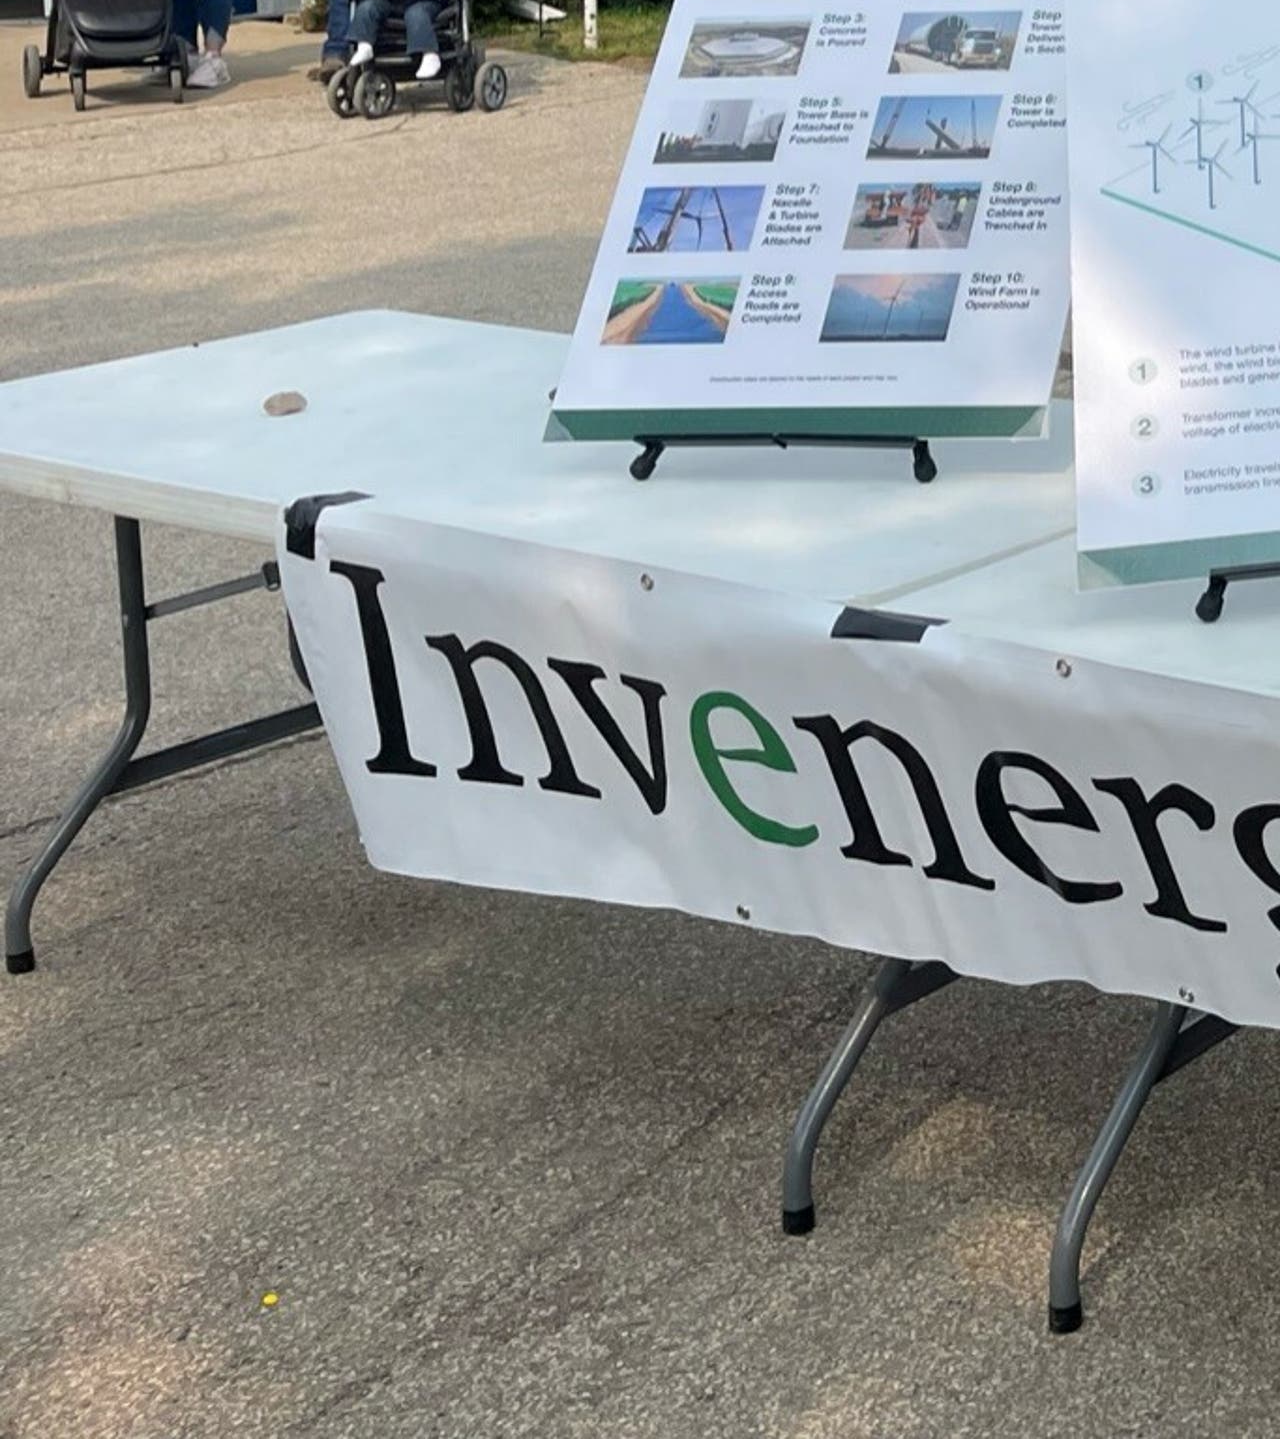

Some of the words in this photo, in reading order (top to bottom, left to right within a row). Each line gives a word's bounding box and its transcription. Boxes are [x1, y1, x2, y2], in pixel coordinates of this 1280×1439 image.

[822, 13, 852, 25] Step
[799, 97, 829, 109] Step
[1012, 93, 1042, 106] Step
[1007, 118, 1067, 130] Completed
[775, 184, 805, 196] Step
[992, 181, 1023, 194] Step
[988, 195, 1062, 207] Underground
[984, 220, 1034, 231] Trenched
[752, 274, 782, 287] Step
[970, 272, 1001, 285] Step
[968, 286, 997, 297] Wind
[998, 286, 1028, 296] Farm
[965, 299, 1031, 311] Operational
[741, 313, 802, 325] Completed
[1138, 419, 1152, 437] 2
[1182, 410, 1251, 424] Transformer
[1140, 476, 1154, 495] 3
[1184, 467, 1242, 482] Electricity
